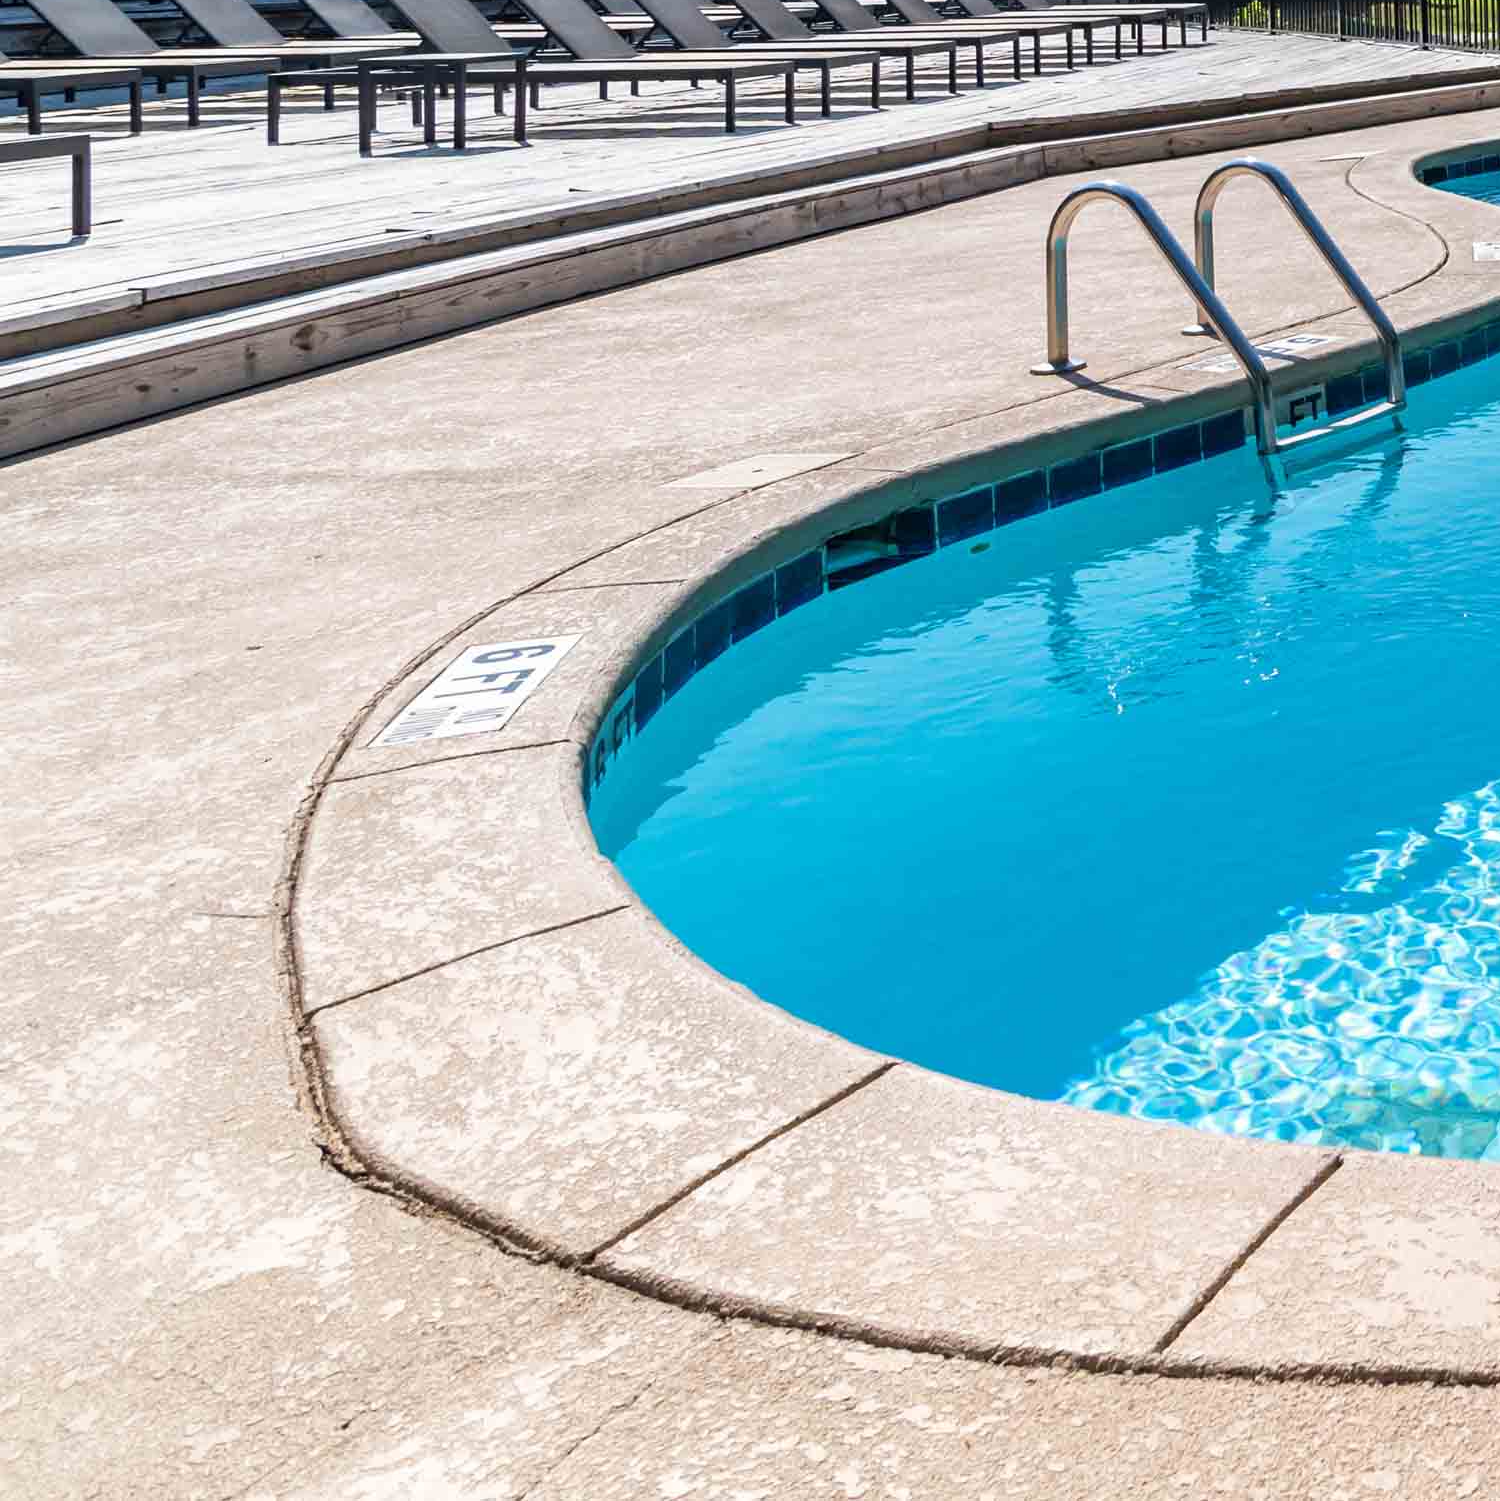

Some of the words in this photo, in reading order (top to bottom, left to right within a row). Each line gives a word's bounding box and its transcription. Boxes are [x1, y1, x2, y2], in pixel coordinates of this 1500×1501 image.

[1289, 392, 1322, 428] FT
[472, 645, 556, 664] 6
[433, 668, 535, 698] FT
